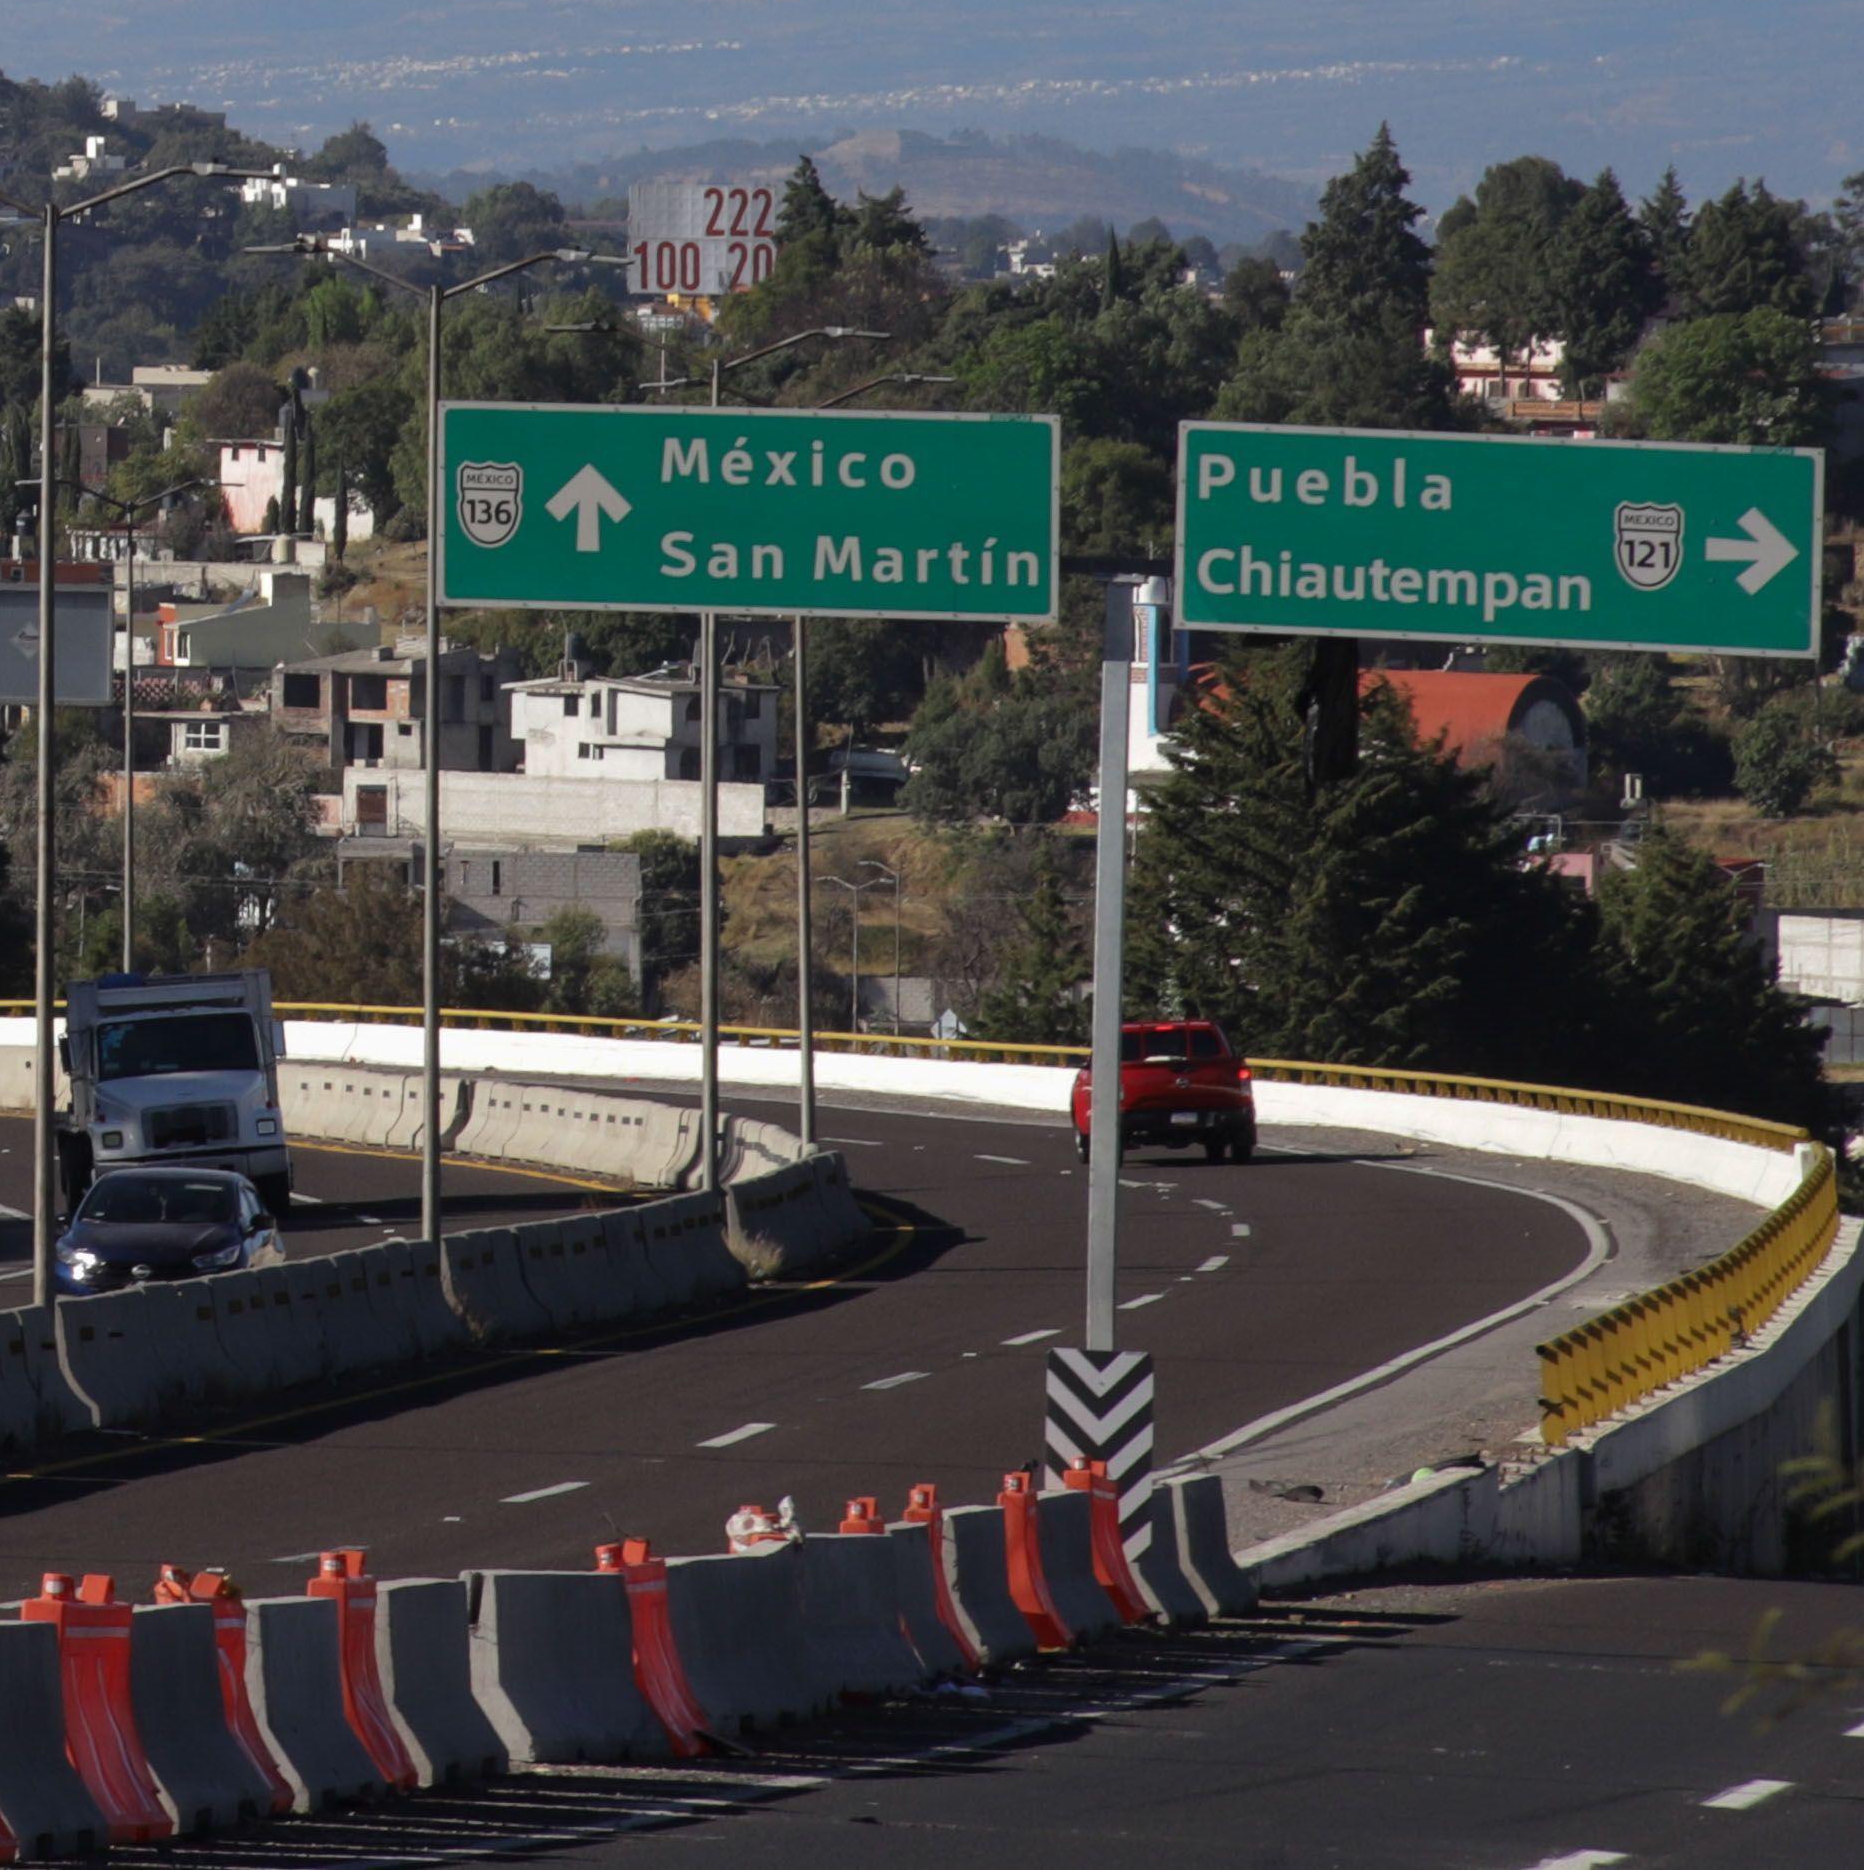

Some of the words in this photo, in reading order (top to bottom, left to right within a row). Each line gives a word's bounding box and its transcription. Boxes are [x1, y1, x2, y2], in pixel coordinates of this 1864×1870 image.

[703, 187, 773, 237] 222
[634, 240, 701, 290] 100
[466, 472, 514, 485] MÉXICO
[659, 436, 917, 489] México
[1197, 453, 1453, 510] Puebla
[466, 499, 512, 525] 136
[659, 530, 784, 580] San
[813, 535, 1040, 587] Martín
[1624, 540, 1671, 569] 121
[1196, 545, 1593, 622] Chiautempan
